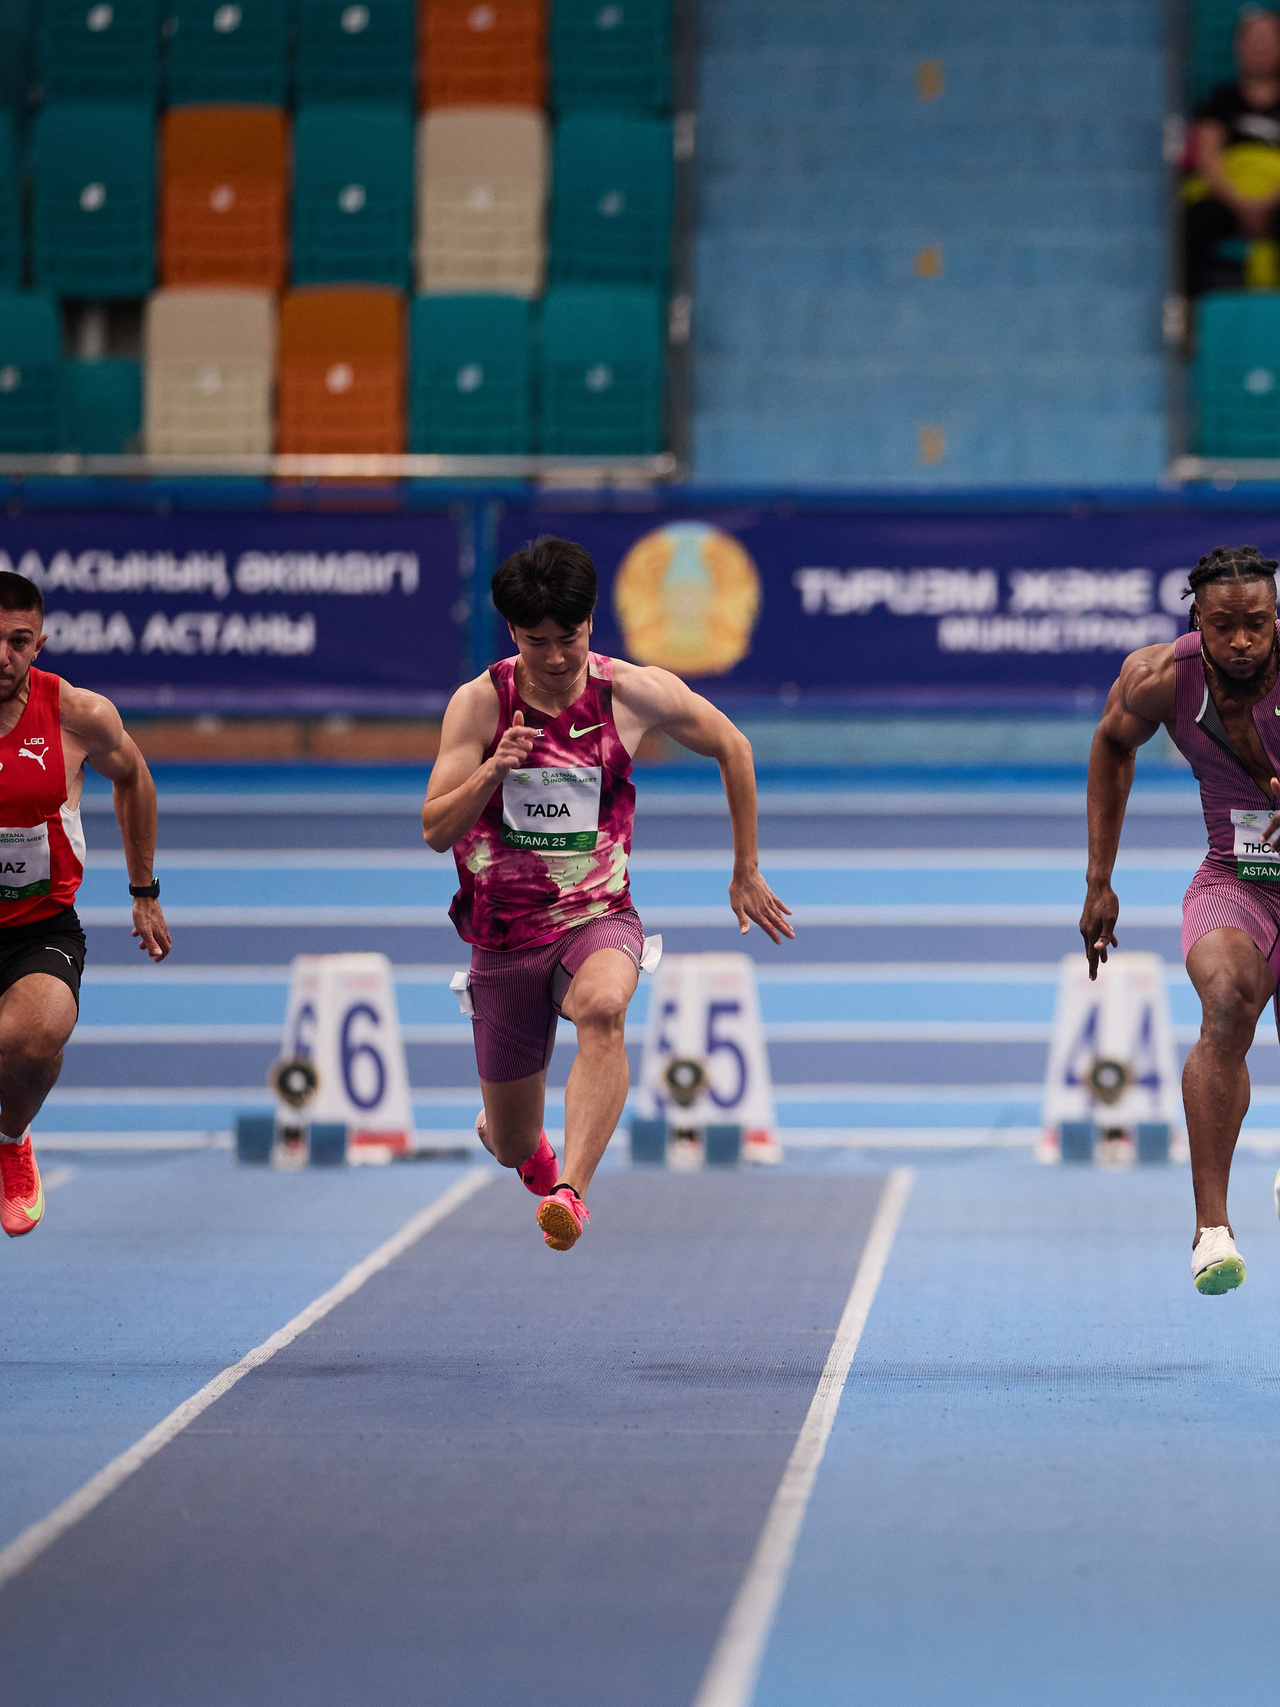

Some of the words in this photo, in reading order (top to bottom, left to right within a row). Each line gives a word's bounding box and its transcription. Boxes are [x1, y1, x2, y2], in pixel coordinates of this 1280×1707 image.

[524, 803, 571, 818] TADA
[27, 834, 46, 842] MEET
[506, 831, 549, 847] ASTANA
[552, 838, 567, 847] 25
[5, 889, 19, 899] 25
[340, 1003, 386, 1112] 6
[706, 1002, 748, 1110] 5
